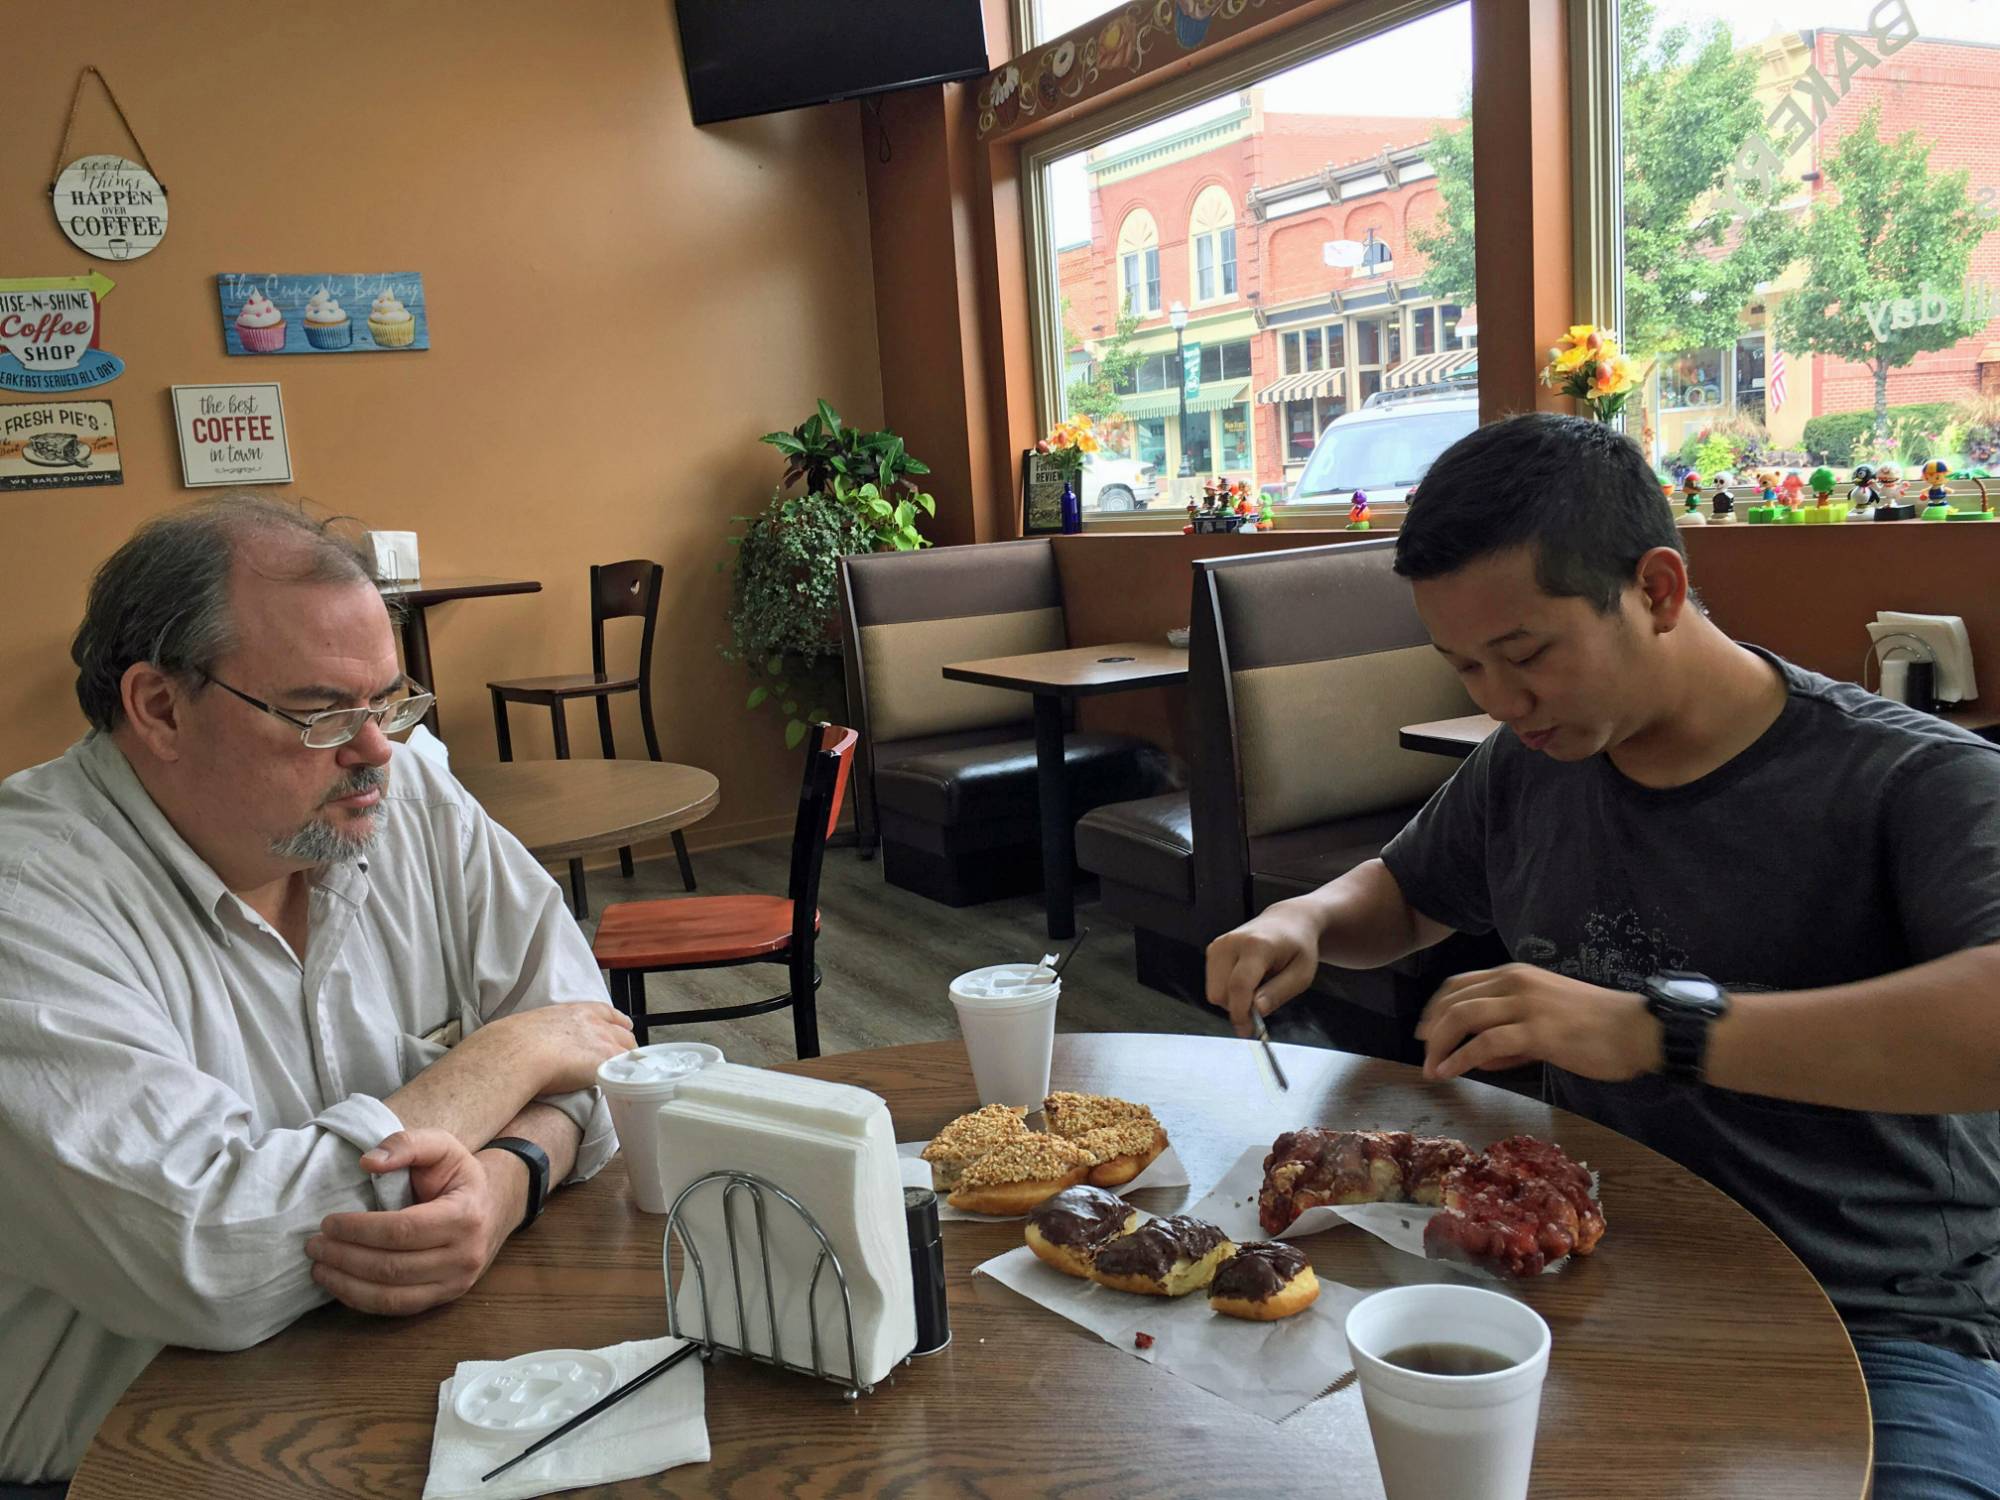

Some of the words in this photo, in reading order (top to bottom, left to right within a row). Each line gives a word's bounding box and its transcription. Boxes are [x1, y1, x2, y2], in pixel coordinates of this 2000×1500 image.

[81, 159, 123, 181] good
[89, 172, 140, 193] things
[70, 190, 153, 206] HAPPEN
[101, 206, 127, 215] OVER
[70, 215, 162, 237] COFFEE
[0, 312, 92, 344] Coffee
[23, 345, 76, 362] SHOP
[44, 374, 79, 388] SERVED
[80, 369, 98, 384] ALL
[96, 360, 117, 378] DAY
[199, 394, 226, 416] the
[228, 394, 259, 415] best
[5, 409, 54, 435] FRESH
[59, 409, 99, 431] PIE'S
[192, 415, 275, 444] COFFEE
[209, 446, 225, 463] in
[227, 443, 264, 463] town
[86, 473, 111, 481] OWN
